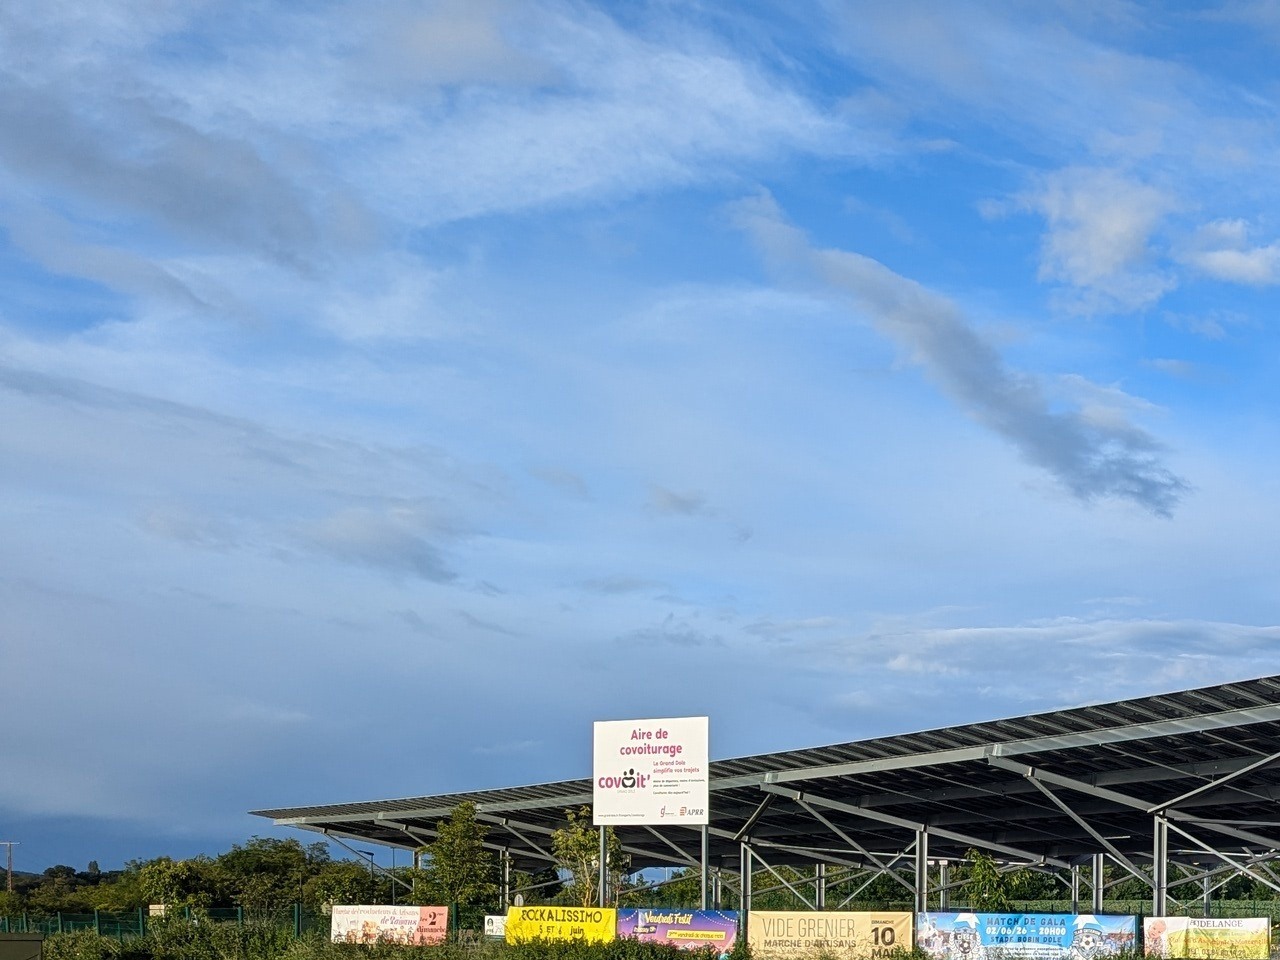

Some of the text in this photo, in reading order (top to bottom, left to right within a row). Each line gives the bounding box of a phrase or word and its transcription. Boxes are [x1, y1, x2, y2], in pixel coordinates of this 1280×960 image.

[630, 728, 668, 740] Aire de
[619, 742, 682, 758] covoiturage
[683, 766, 700, 774] trajets
[686, 808, 705, 816] APRR
[644, 911, 694, 926] Vendredi Festif
[986, 917, 1066, 926] MATCH DE GALA
[417, 925, 446, 933] dimanche
[546, 926, 555, 934] ET
[569, 925, 584, 936] juin
[762, 918, 856, 938] VIDE GRENIER
[985, 926, 1027, 935] 02/06/26
[1038, 926, 1067, 936] 20H00
[871, 926, 896, 946] 10
[990, 935, 1014, 943] STADE
[764, 937, 802, 948] MARCHÉ
[871, 948, 894, 959] MAI
